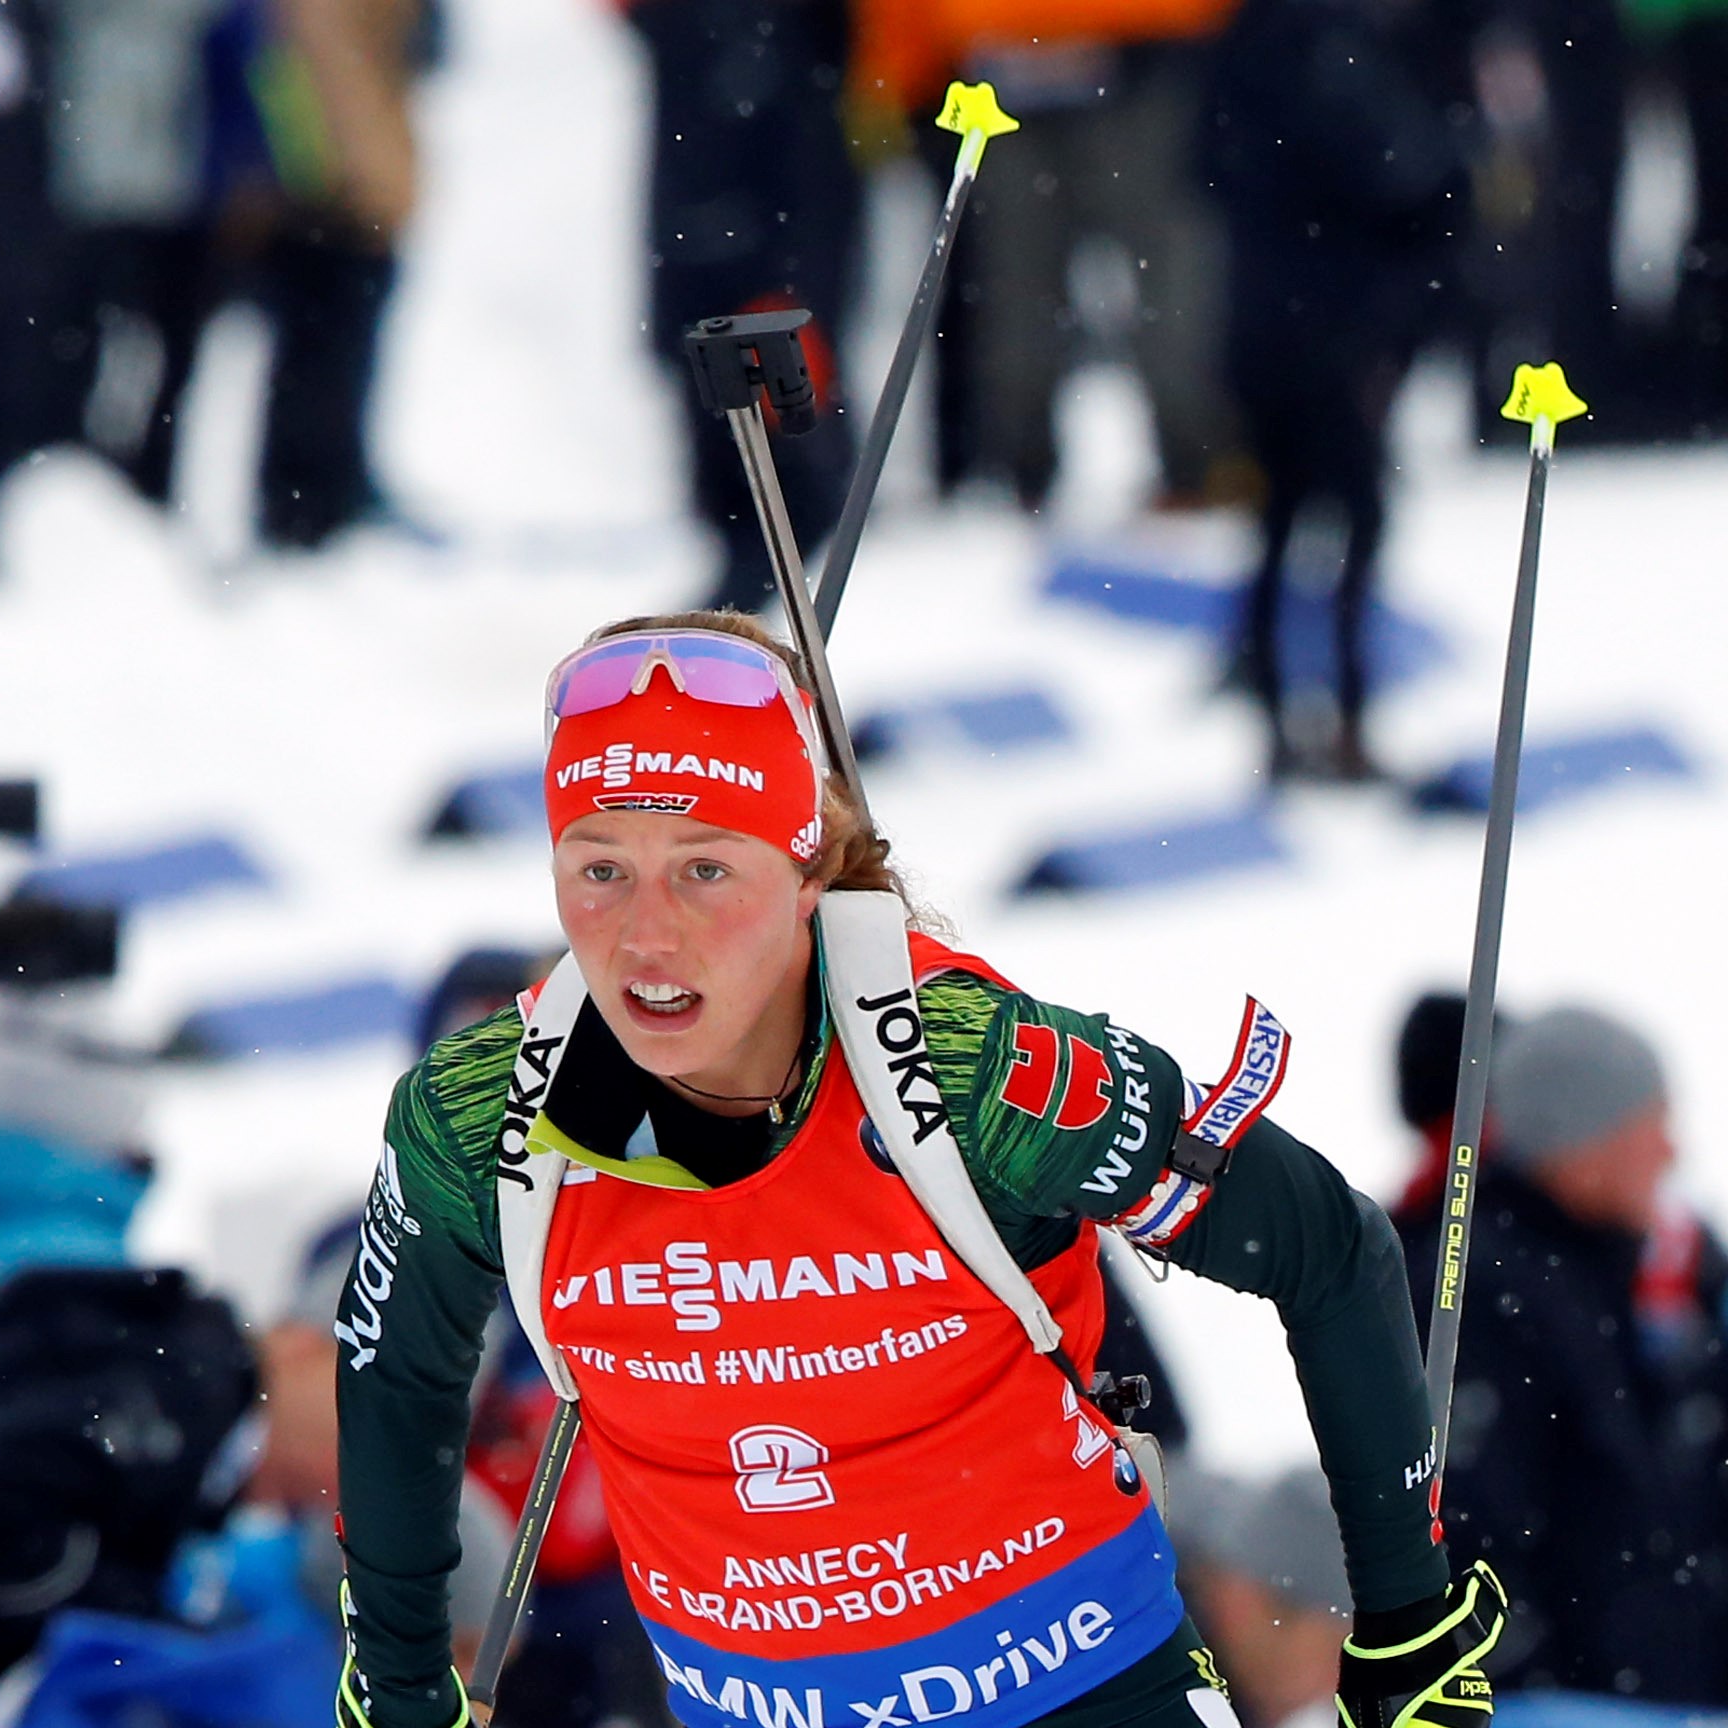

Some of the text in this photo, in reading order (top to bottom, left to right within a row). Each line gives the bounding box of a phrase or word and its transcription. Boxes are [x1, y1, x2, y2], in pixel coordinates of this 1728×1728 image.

[556, 742, 765, 792] VIESSMANN
[492, 1030, 565, 1193] JOKA
[856, 988, 949, 1147] JOKA
[1080, 1025, 1153, 1197] WÜRTH
[1450, 1172, 1469, 1218] SLG
[553, 1241, 949, 1332] VIESSMANN
[1440, 1223, 1465, 1311] PREMIO
[625, 1351, 706, 1386] sind
[714, 1313, 969, 1386] #Winterfans
[728, 1423, 836, 1514] 2
[681, 1516, 1066, 1634] GRAND-BORNAND
[723, 1533, 909, 1590] ANNECY
